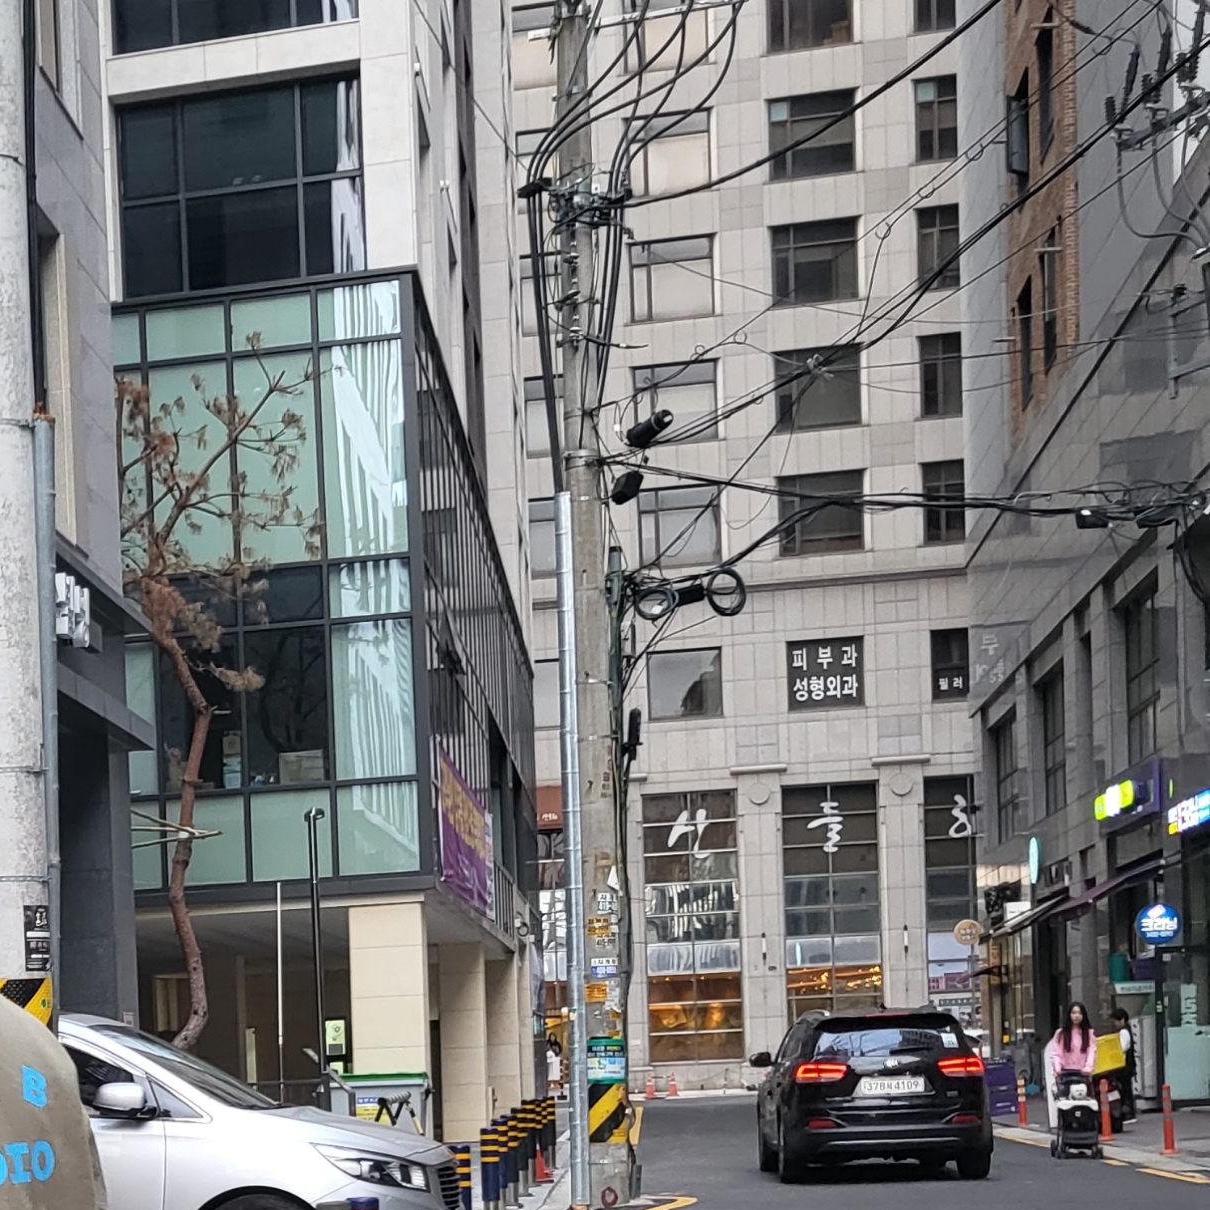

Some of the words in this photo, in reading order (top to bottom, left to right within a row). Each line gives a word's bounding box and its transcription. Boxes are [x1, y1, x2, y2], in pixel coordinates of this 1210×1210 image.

[792, 644, 858, 671] 피부과
[793, 674, 858, 701] 성형외과
[939, 676, 963, 690] 필러
[1141, 916, 1178, 931] 크리닝
